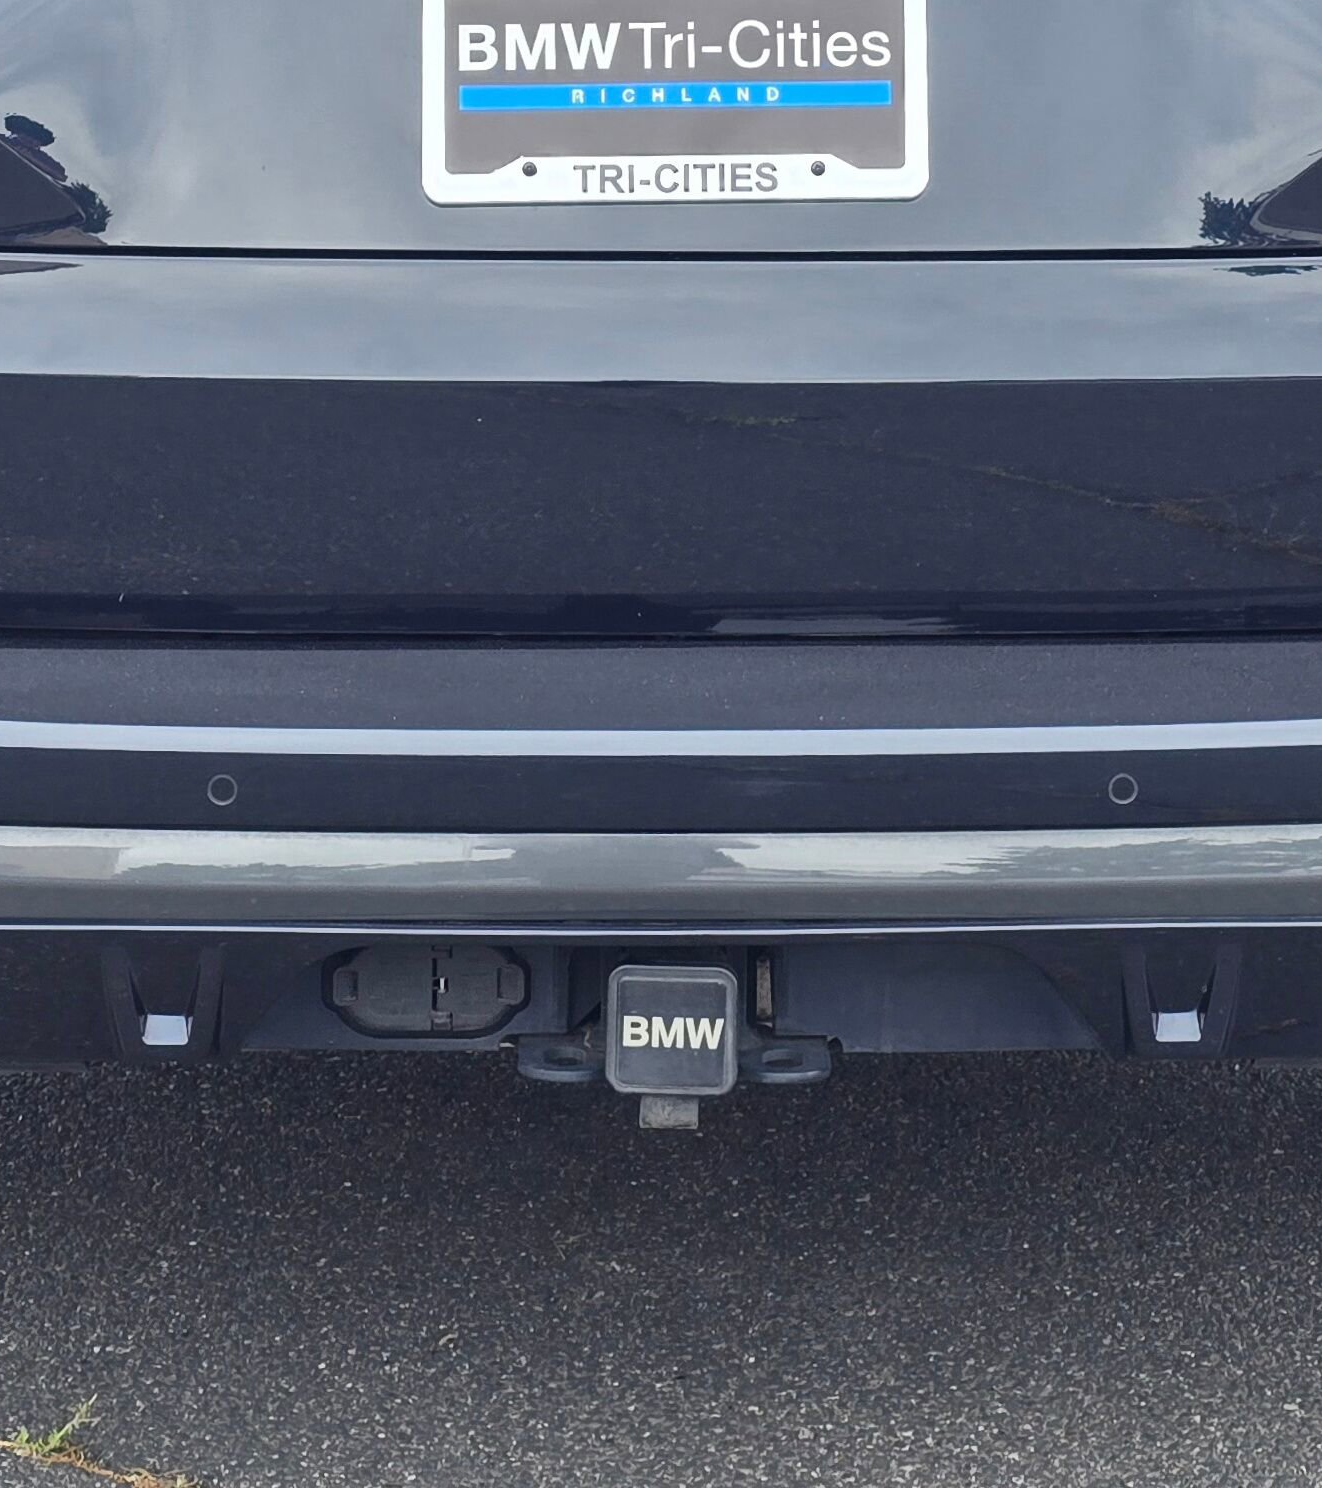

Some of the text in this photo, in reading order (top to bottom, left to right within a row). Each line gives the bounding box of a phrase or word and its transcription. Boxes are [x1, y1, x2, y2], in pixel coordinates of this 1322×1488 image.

[457, 19, 892, 72] BMW Tri-Cities
[570, 85, 782, 104] RICHLAND
[572, 161, 779, 194] TRI-CITIES
[622, 1015, 725, 1050] BMW
